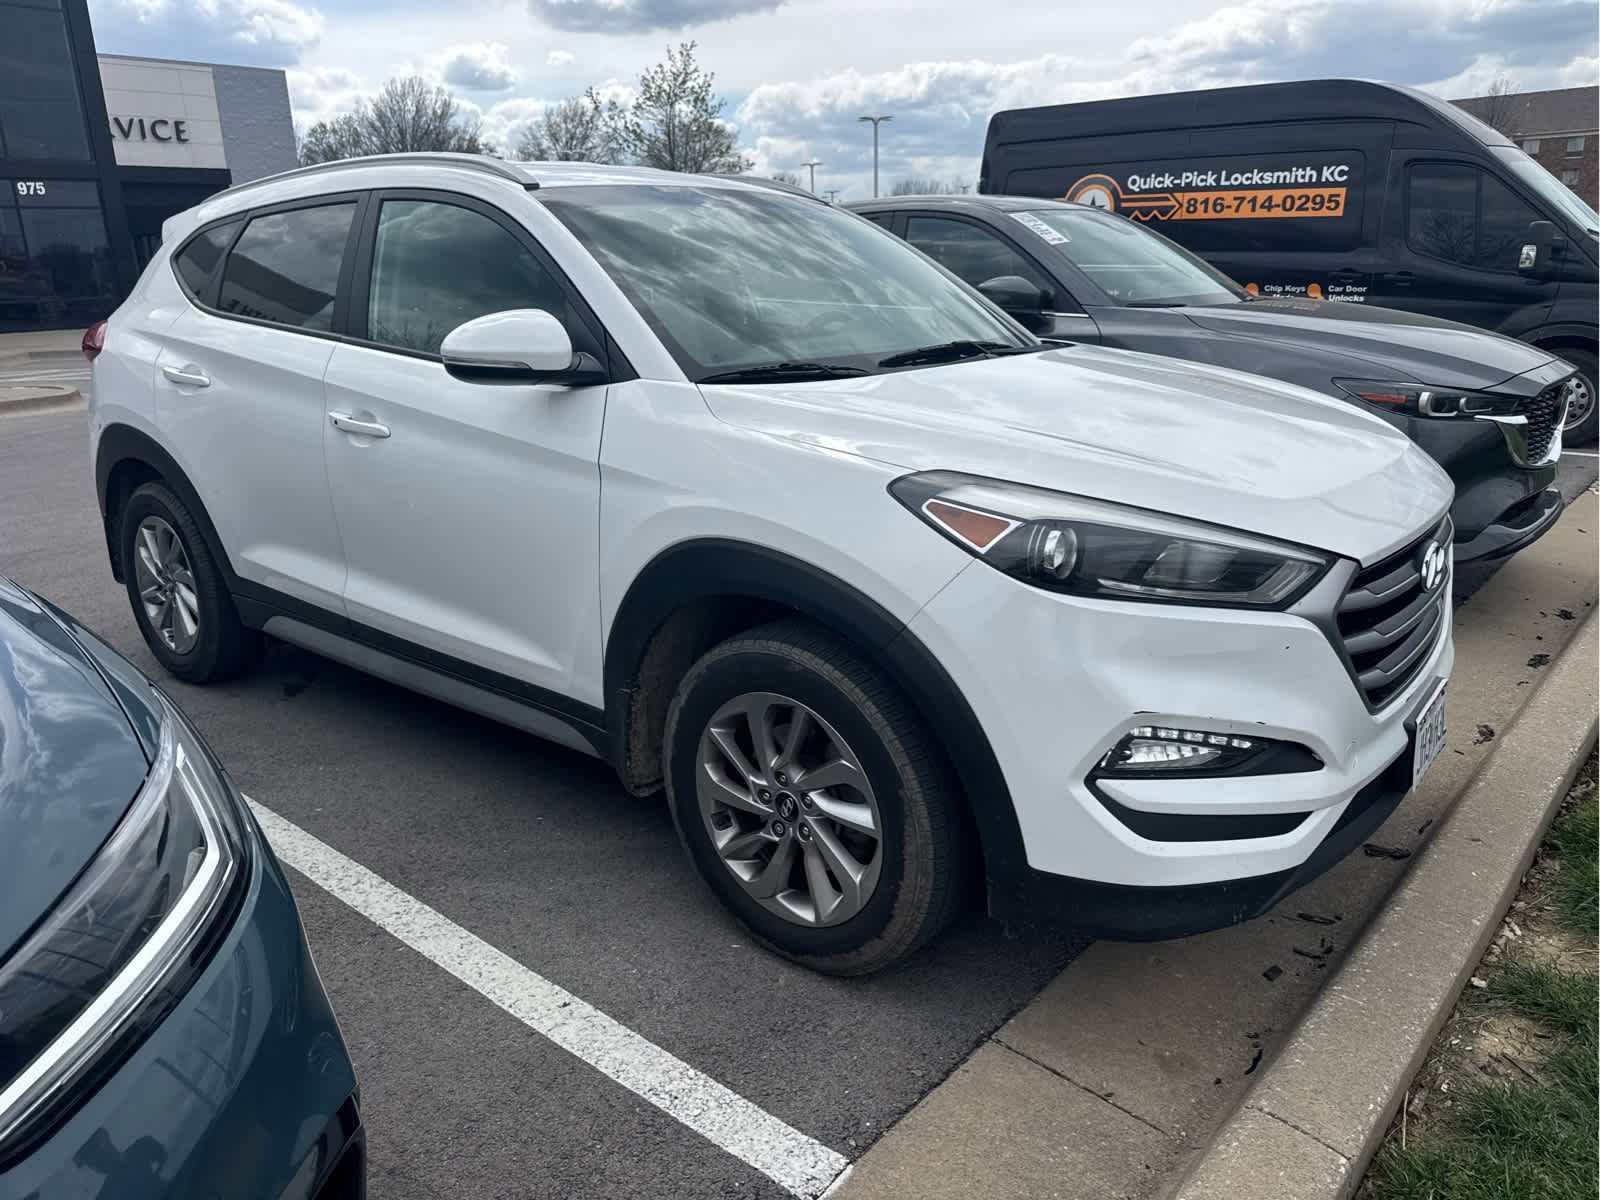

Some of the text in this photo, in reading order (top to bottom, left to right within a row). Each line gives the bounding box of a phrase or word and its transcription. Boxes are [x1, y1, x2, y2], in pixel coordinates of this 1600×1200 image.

[111, 117, 190, 142] VICE
[1127, 165, 1350, 192] Quick-Pick Locksmith KC
[17, 182, 46, 195] 975
[1185, 193, 1341, 214] 816-714-0295
[1264, 285, 1306, 293] Chip Keys
[1328, 294, 1364, 302] Unlocks
